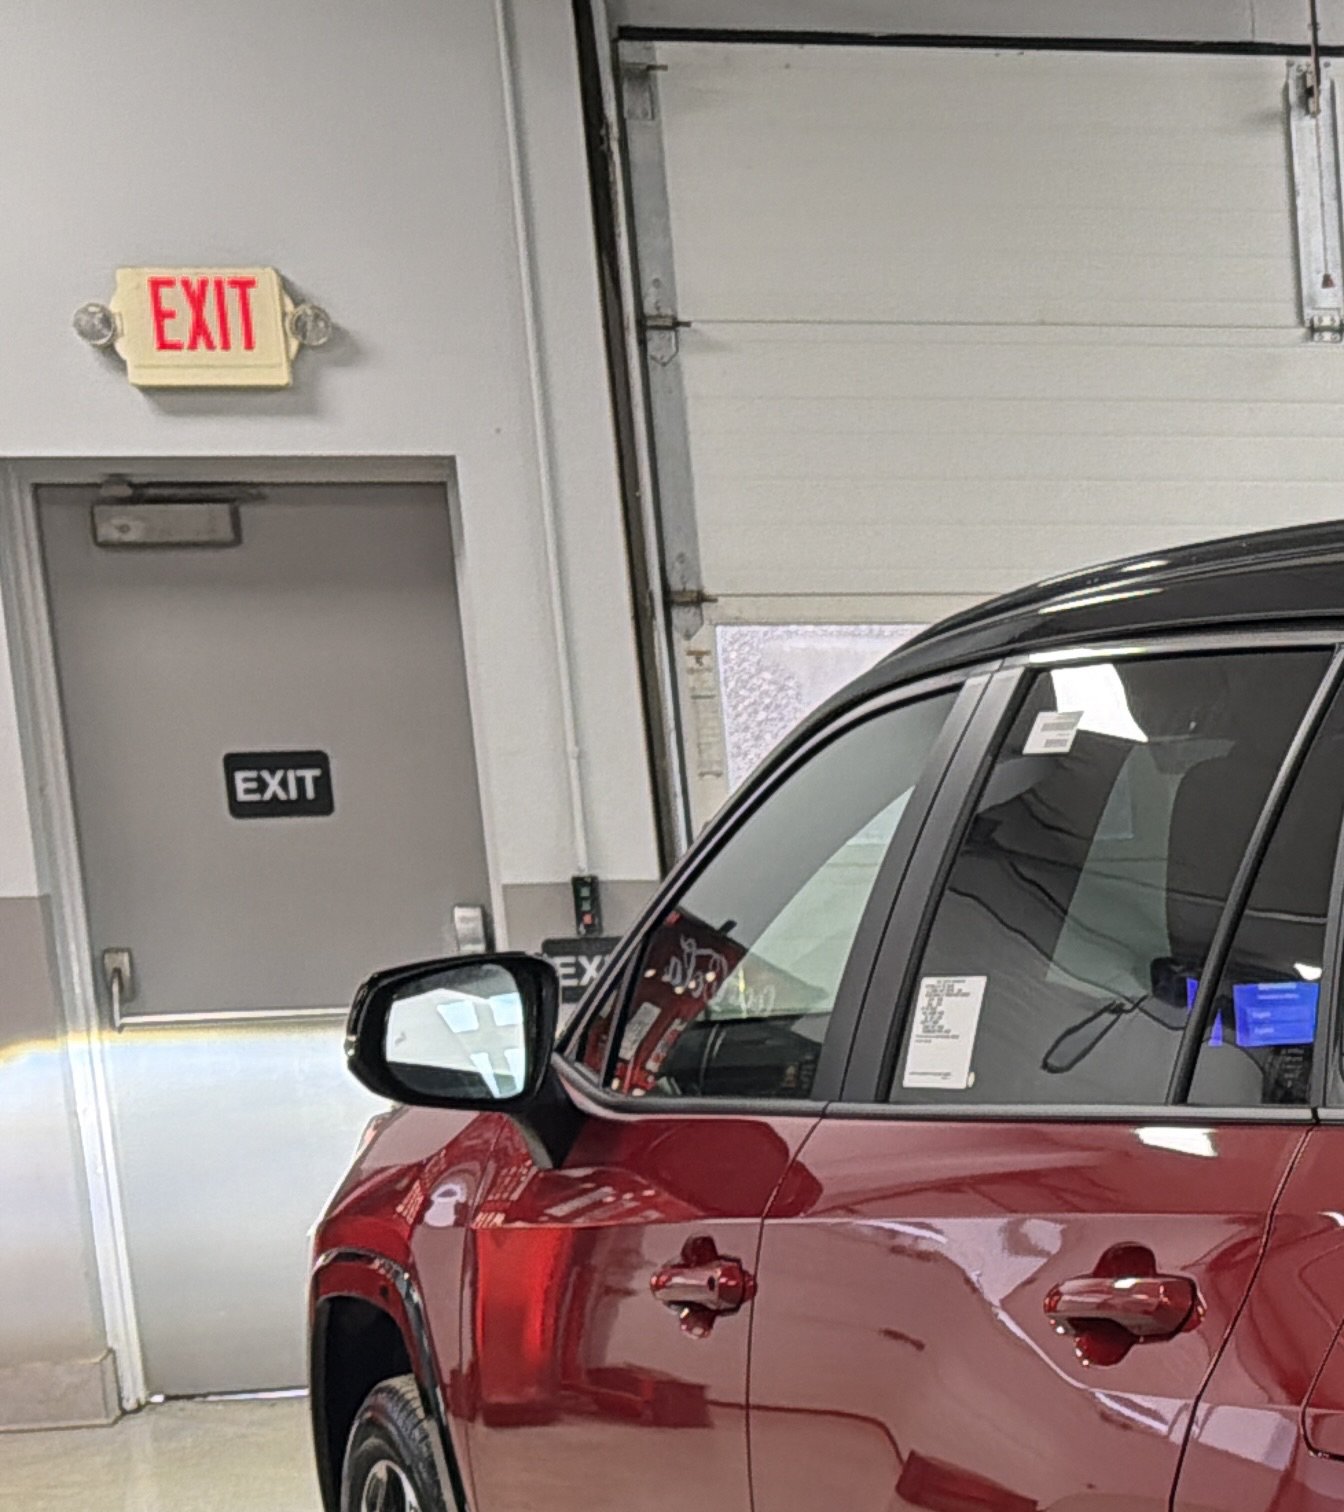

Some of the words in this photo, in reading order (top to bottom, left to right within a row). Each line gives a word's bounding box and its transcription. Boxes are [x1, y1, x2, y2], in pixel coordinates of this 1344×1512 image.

[148, 276, 257, 351] EXIT
[233, 768, 322, 803] EXIT
[553, 955, 609, 987] EX
